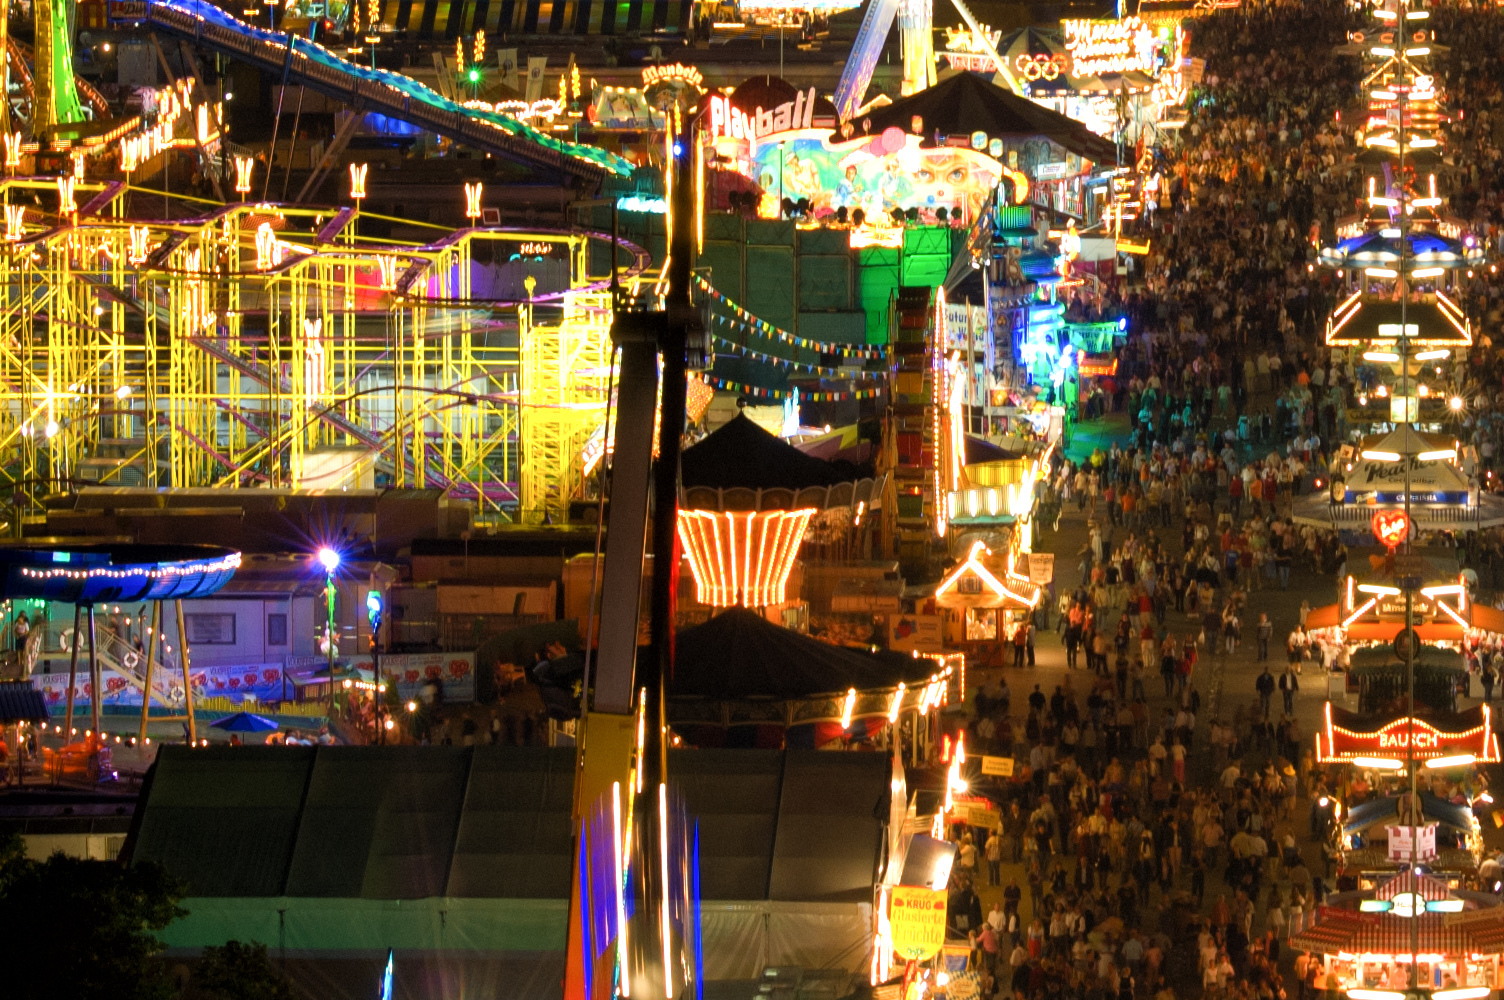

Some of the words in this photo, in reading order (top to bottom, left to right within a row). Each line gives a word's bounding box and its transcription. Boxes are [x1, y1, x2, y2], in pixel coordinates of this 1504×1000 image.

[641, 61, 704, 85] Mandeln
[710, 86, 817, 159] Playball
[906, 899, 932, 911] KRUG
[892, 908, 945, 925] Glasierte
[895, 923, 942, 945] Früchte
